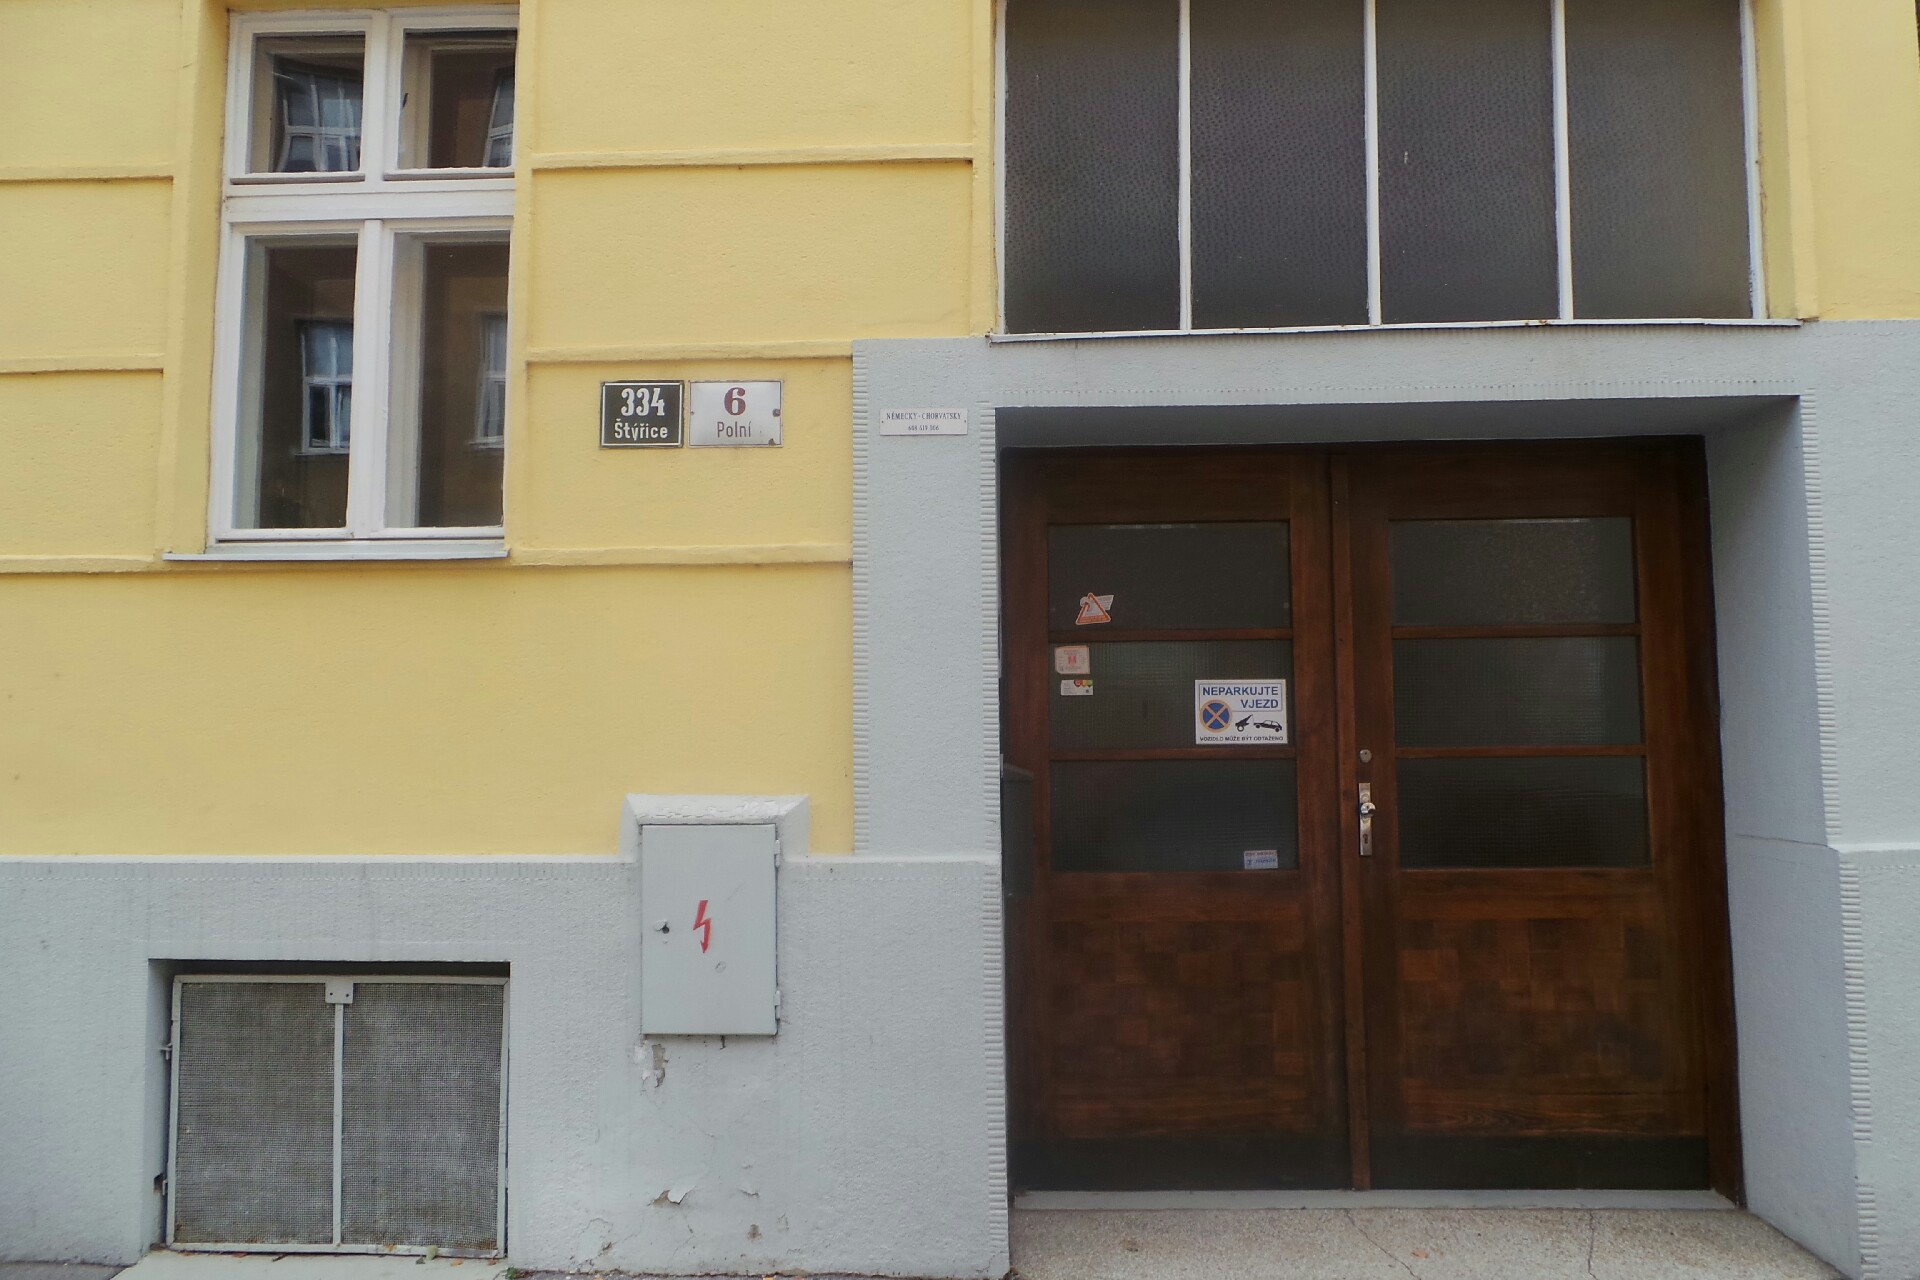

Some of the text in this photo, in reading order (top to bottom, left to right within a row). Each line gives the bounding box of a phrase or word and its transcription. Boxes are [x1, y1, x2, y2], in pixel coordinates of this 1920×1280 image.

[621, 387, 665, 416] 334
[724, 387, 746, 416] 6
[614, 418, 668, 441] Štýřice
[717, 420, 752, 438] Polní
[1202, 686, 1279, 696] NEPARKUJTE
[1240, 699, 1279, 709] VJEZD
